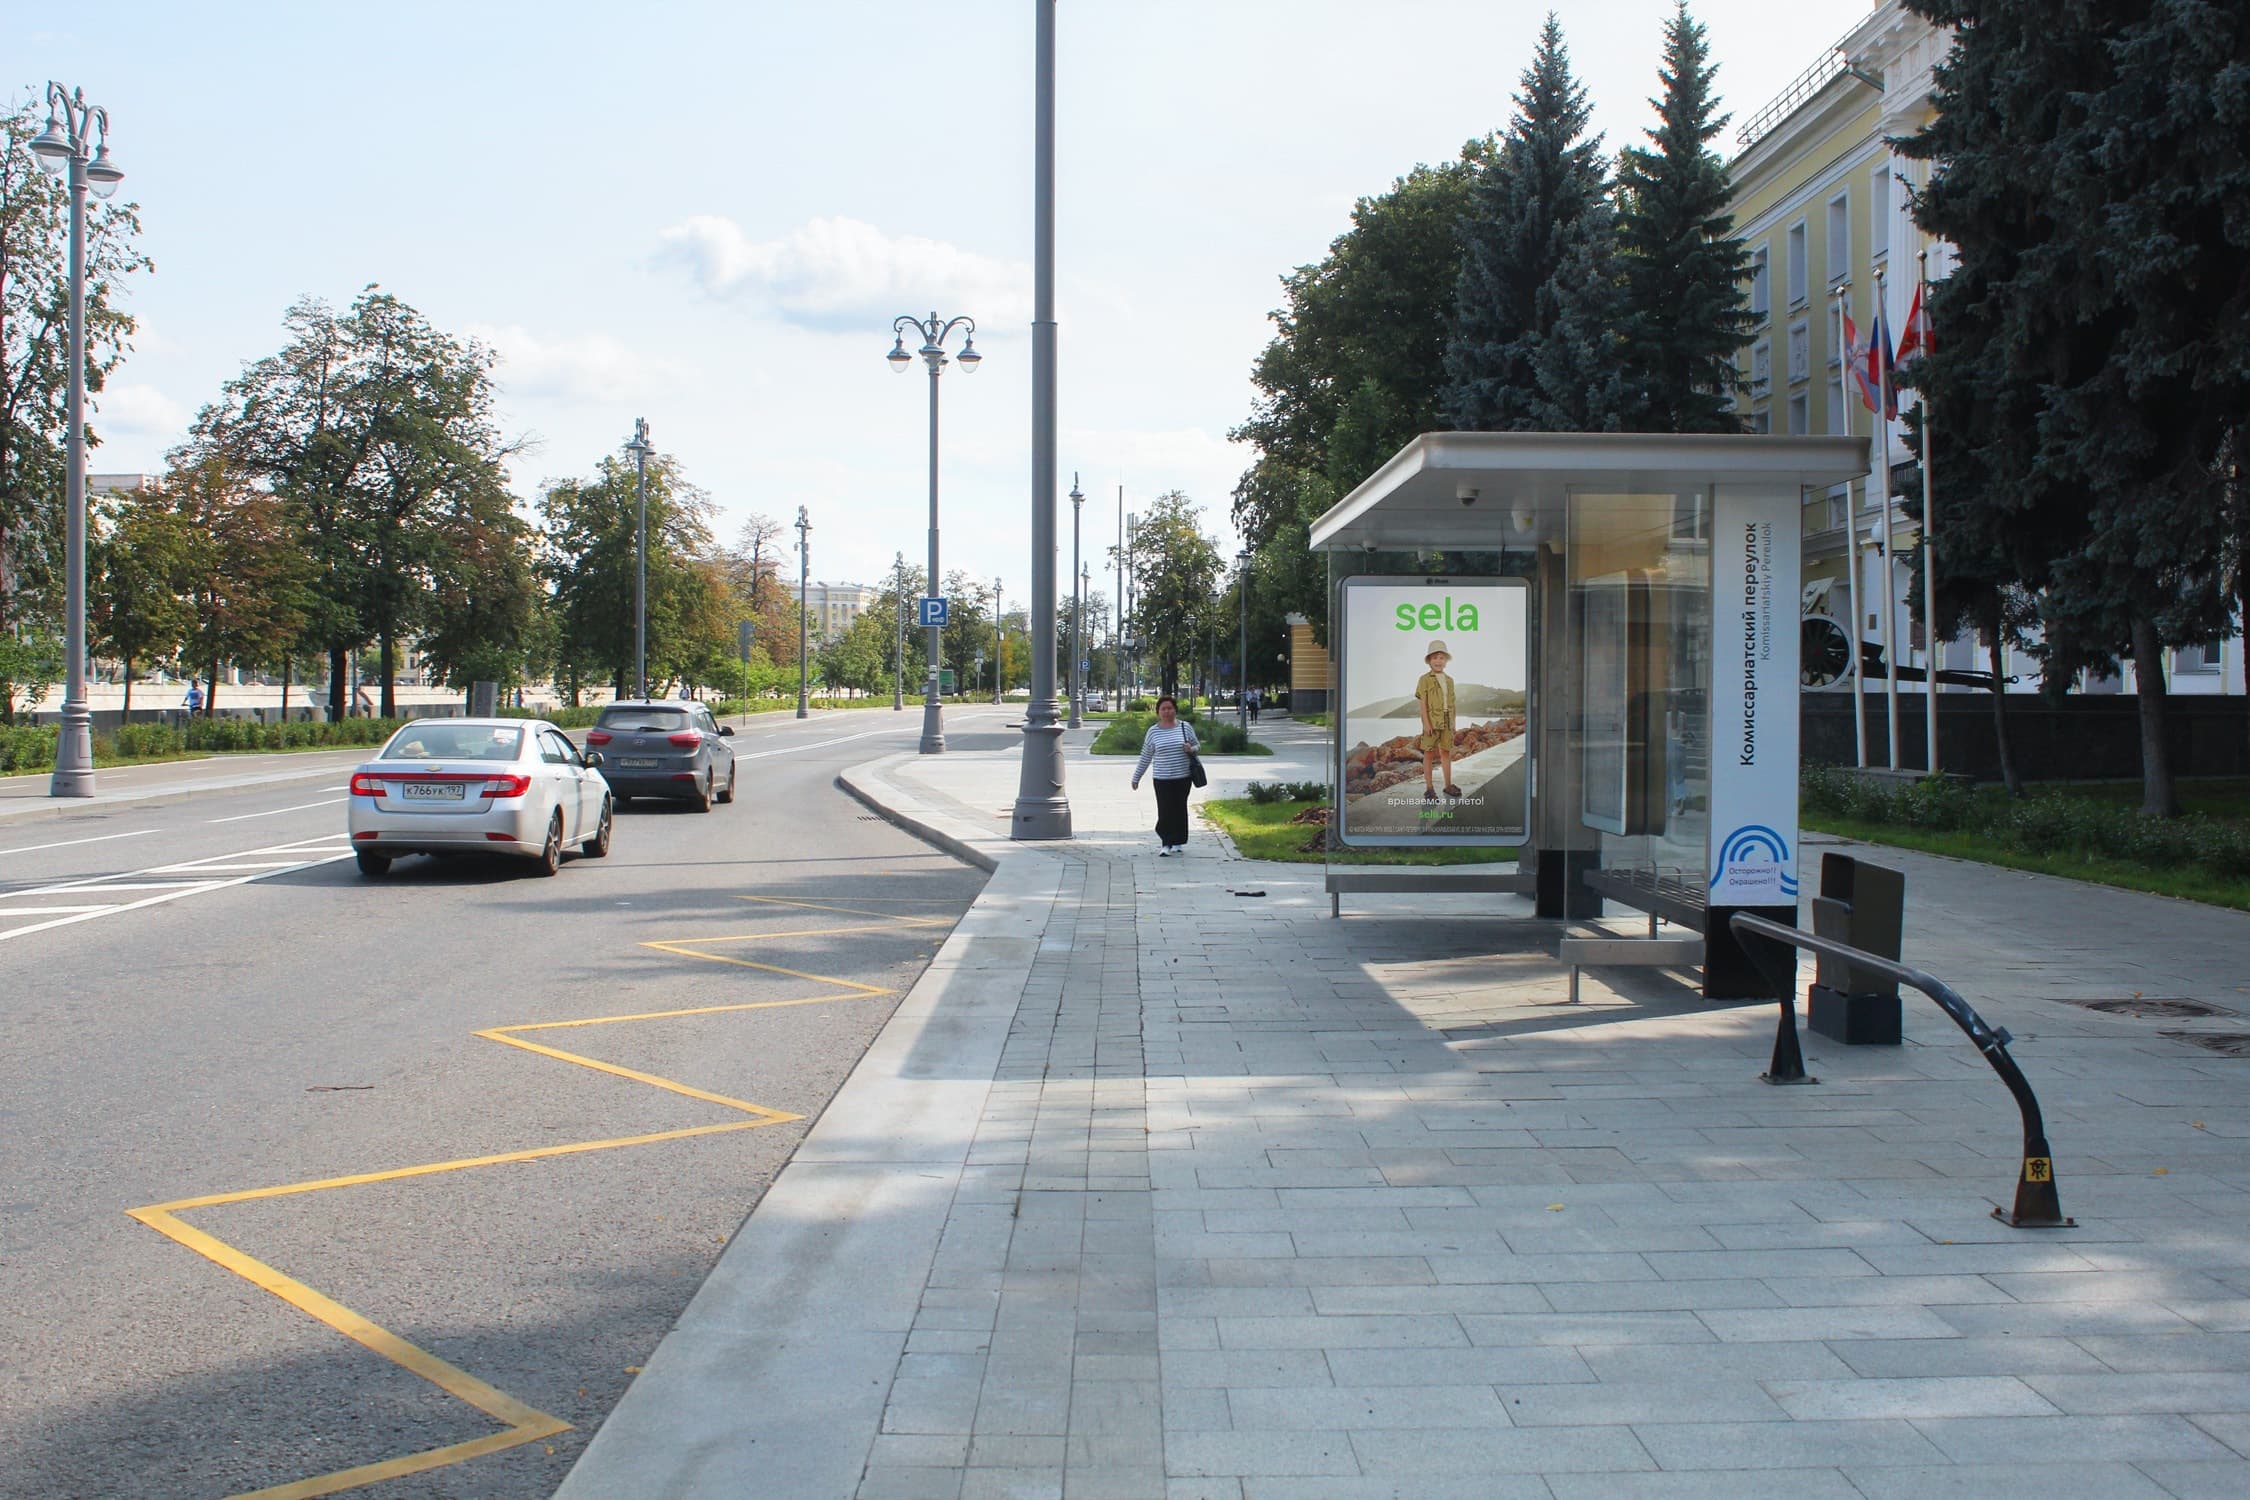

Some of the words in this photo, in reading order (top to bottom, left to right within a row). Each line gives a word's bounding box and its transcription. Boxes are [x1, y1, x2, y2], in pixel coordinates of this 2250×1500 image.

[1745, 523, 1760, 606] переулок
[1760, 522, 1771, 571] Pereulok
[927, 601, 942, 623] P
[1395, 596, 1479, 632] sela
[1760, 574, 1772, 660] Komissariatskiy
[1740, 612, 1757, 766] Комиссариатский
[1417, 809, 1454, 819] sela.ru
[1449, 798, 1456, 806] в
[1458, 796, 1484, 806] лето!
